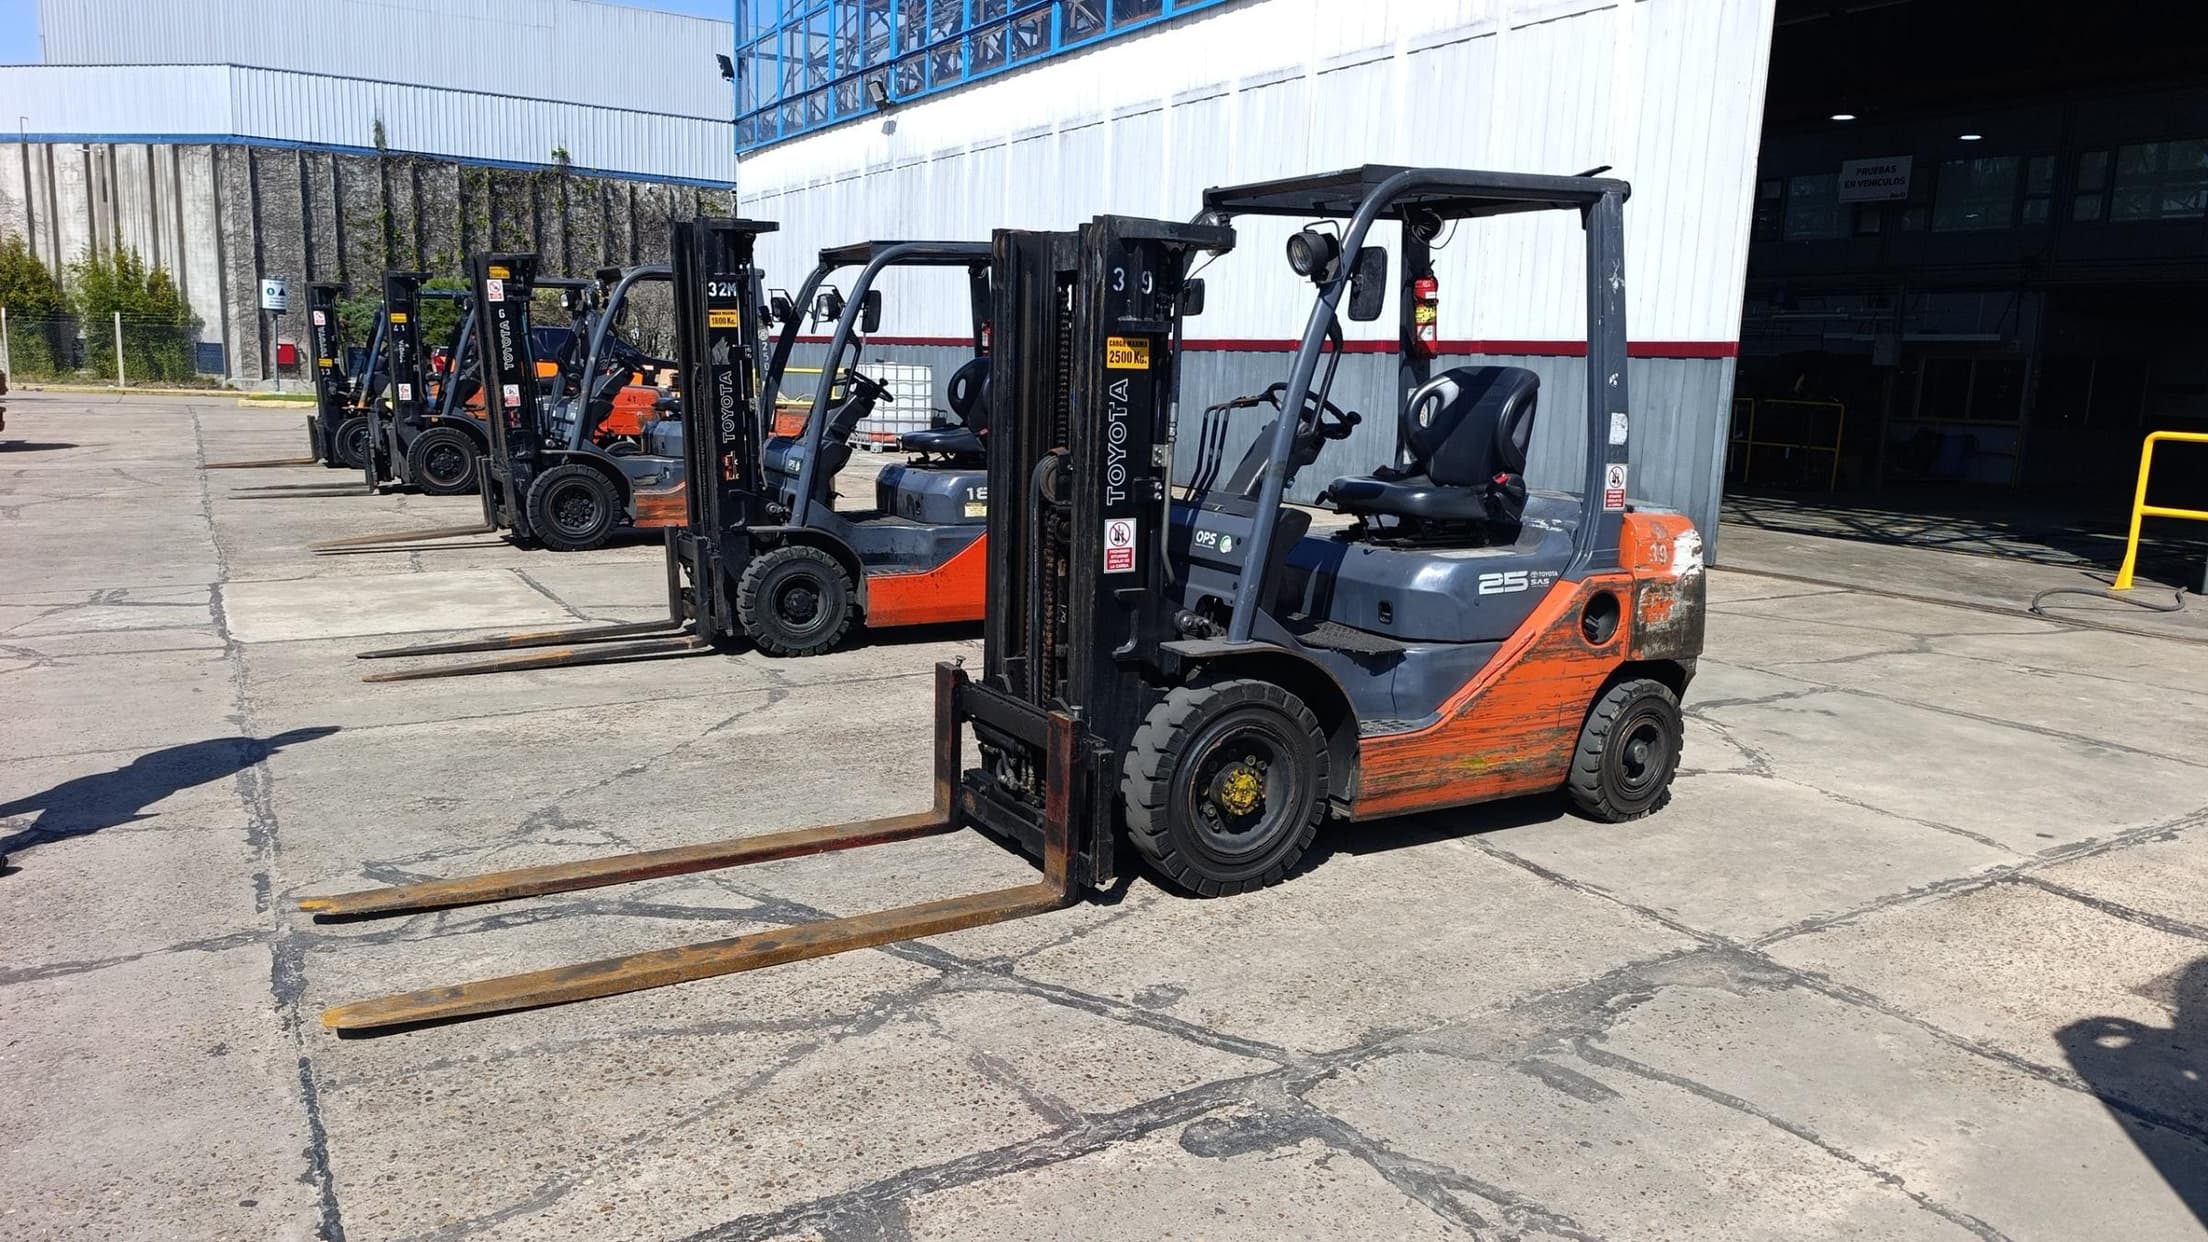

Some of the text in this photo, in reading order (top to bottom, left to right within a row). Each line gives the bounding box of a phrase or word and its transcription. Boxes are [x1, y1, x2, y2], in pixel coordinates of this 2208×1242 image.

[1856, 165, 1897, 176] PRUEBAS
[708, 282, 737, 297] 32M
[499, 320, 515, 371] TOYOTA
[1109, 350, 1133, 363] 2500
[719, 370, 736, 444] TOYOTA
[1106, 378, 1129, 506] TOYOTA
[1195, 530, 1218, 545] OPS
[1649, 543, 1669, 564] 39
[1478, 570, 1529, 595] 25
